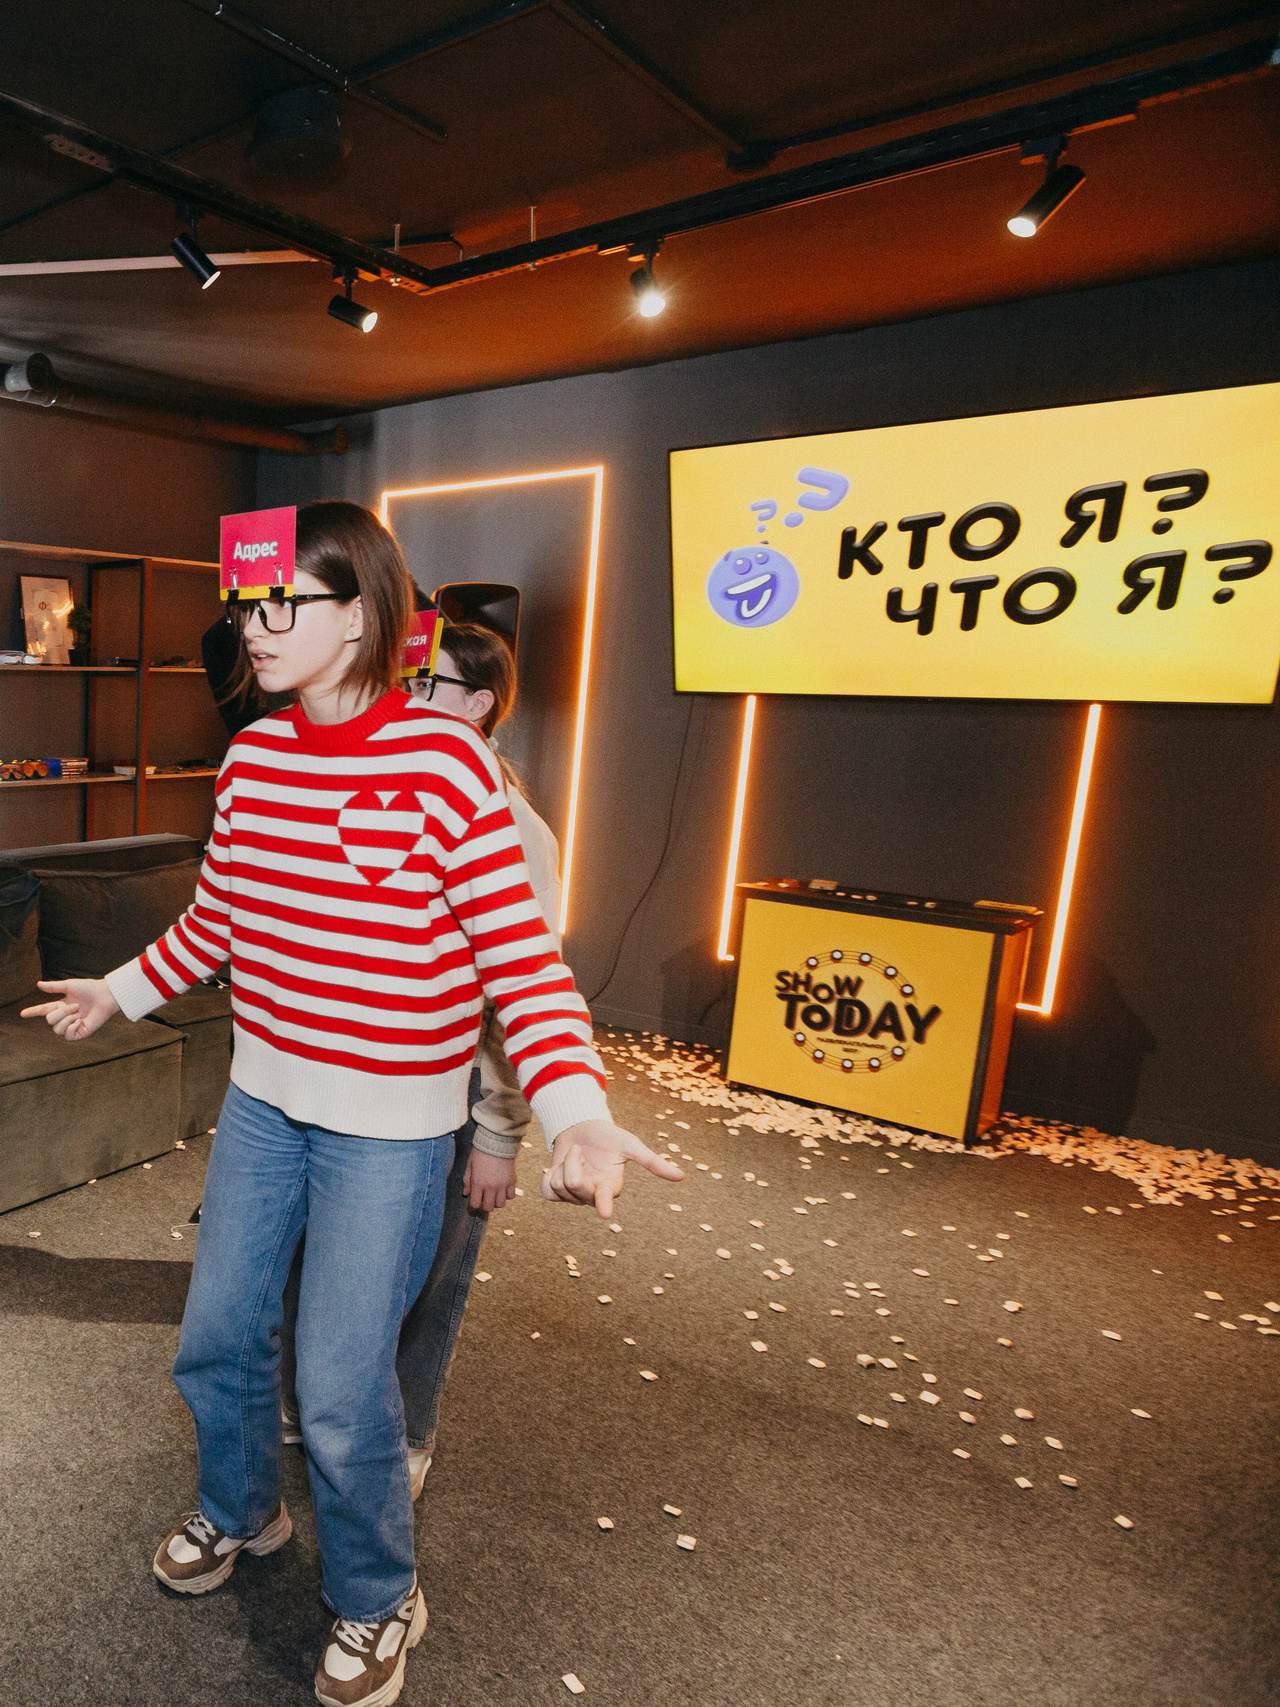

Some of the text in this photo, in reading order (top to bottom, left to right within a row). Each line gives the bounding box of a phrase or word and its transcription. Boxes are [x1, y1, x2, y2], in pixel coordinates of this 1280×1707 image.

[233, 541, 278, 562] Адрес
[837, 502, 1021, 580] КТО
[885, 566, 1077, 636] ЧТО
